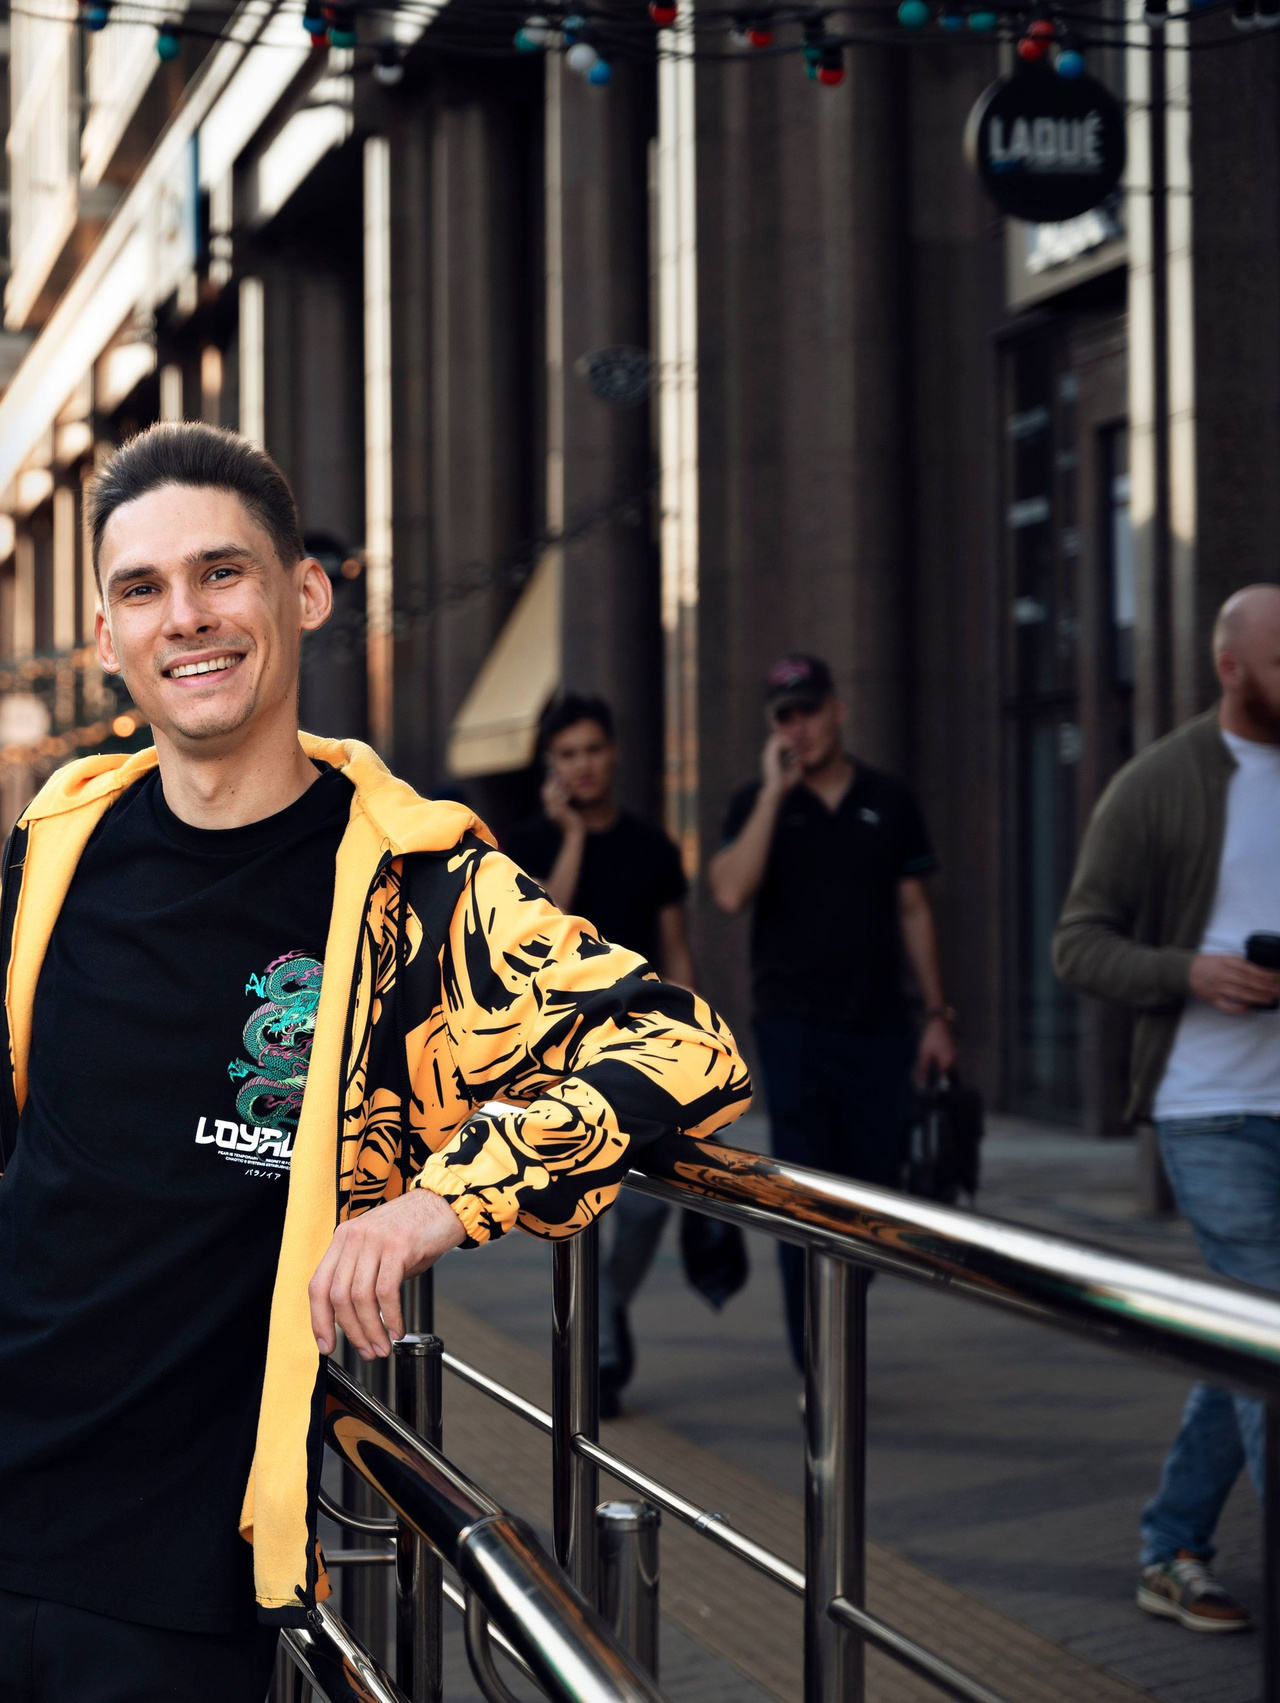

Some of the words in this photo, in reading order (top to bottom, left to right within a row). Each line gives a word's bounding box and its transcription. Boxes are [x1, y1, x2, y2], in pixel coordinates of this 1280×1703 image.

[245, 1169, 281, 1180] パラノイア
